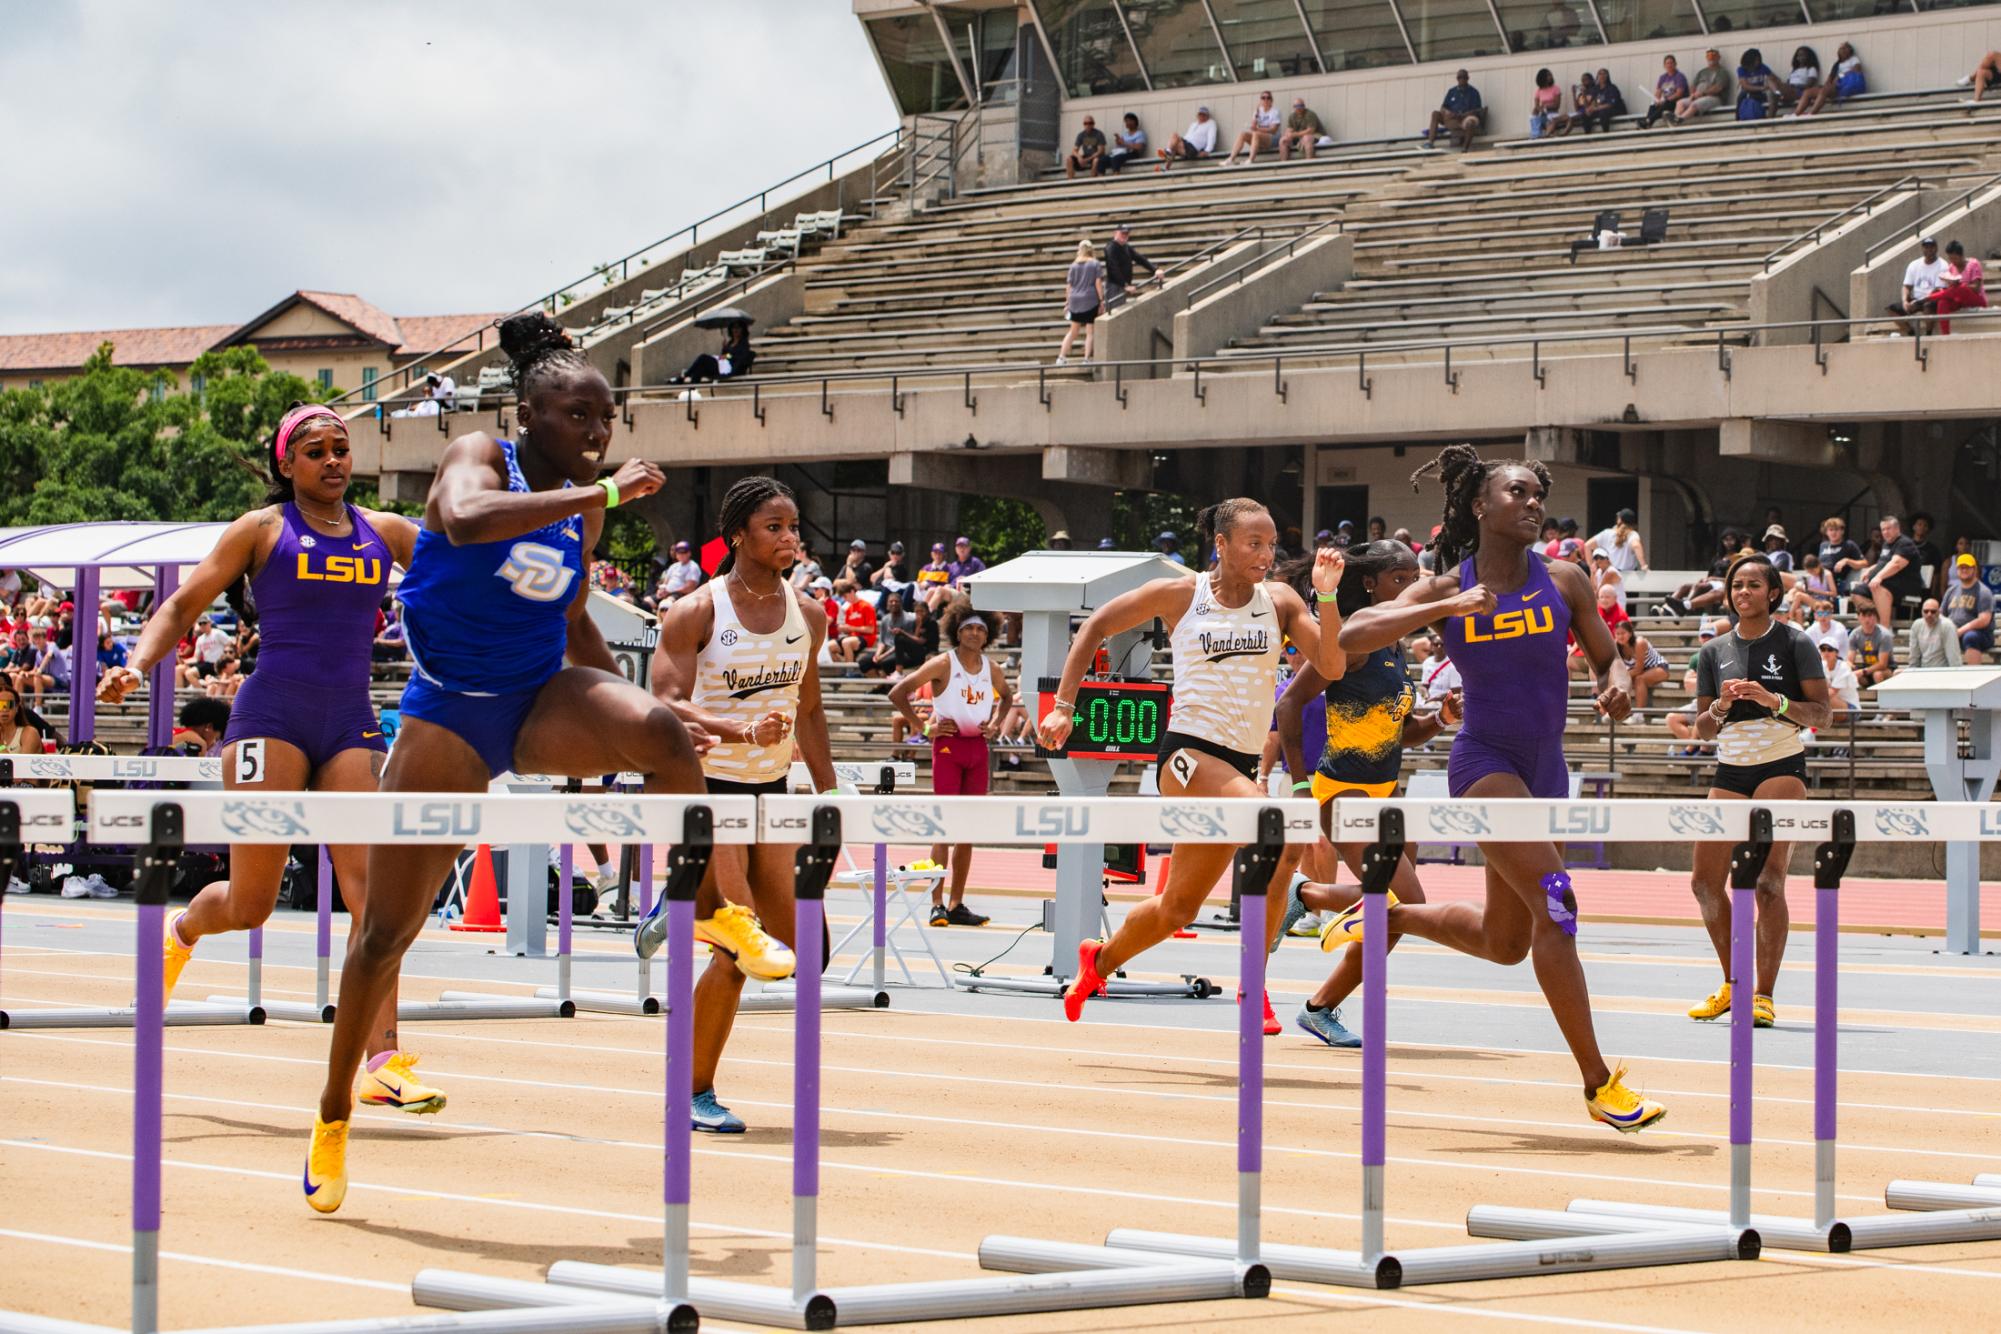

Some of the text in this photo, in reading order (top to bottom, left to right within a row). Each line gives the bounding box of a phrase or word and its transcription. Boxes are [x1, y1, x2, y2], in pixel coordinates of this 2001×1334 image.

[297, 552, 381, 585] LSU
[1465, 606, 1555, 644] LSU
[1199, 630, 1268, 655] Vanderbilt
[723, 660, 802, 690] Vanderbilt
[113, 760, 157, 777] LSU
[242, 742, 257, 781] 5
[99, 816, 144, 827] UCS
[393, 802, 481, 836] LSU
[770, 818, 807, 829] UCS
[1016, 805, 1090, 836] LSU
[1343, 818, 1375, 828] UCS
[1549, 806, 1611, 834] LSU
[1801, 820, 1828, 829] UCS
